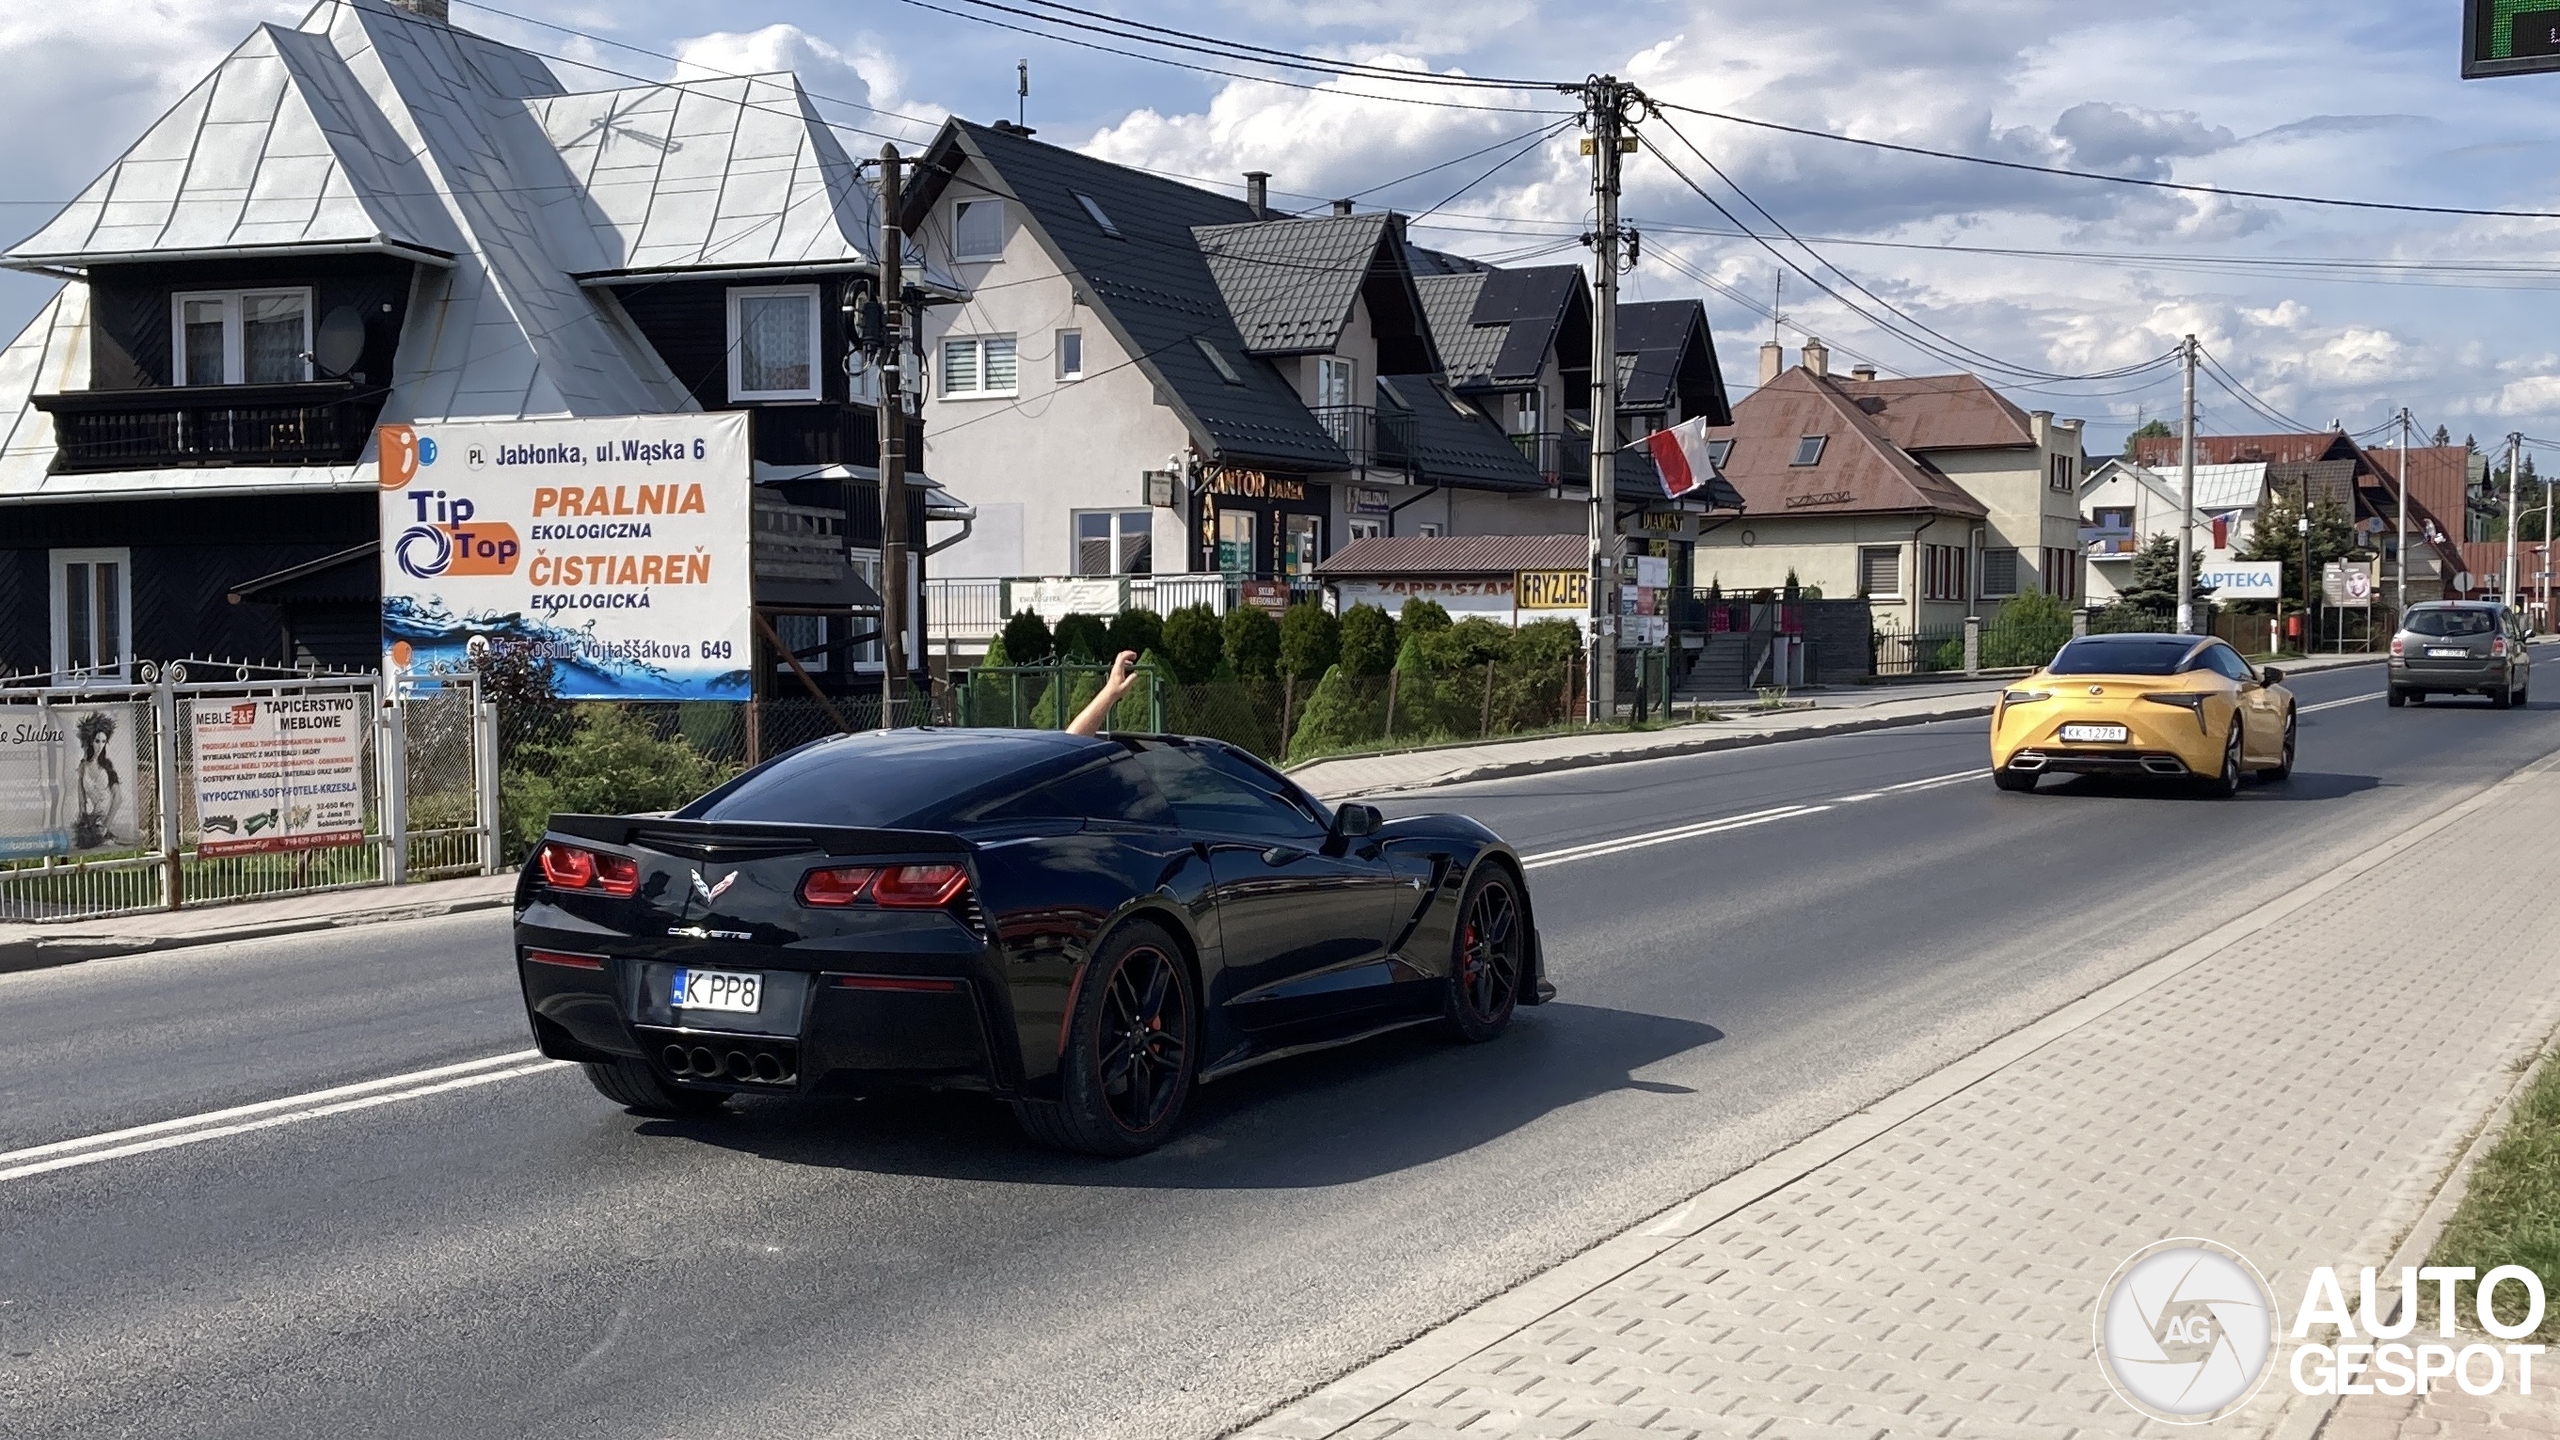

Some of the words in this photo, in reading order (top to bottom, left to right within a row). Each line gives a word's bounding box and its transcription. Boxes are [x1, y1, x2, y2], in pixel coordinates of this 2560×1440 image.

[469, 450, 485, 465] PL
[496, 443, 587, 467] Jabłonka,
[596, 439, 685, 467] ul.Wąska
[693, 438, 705, 460] 6
[1202, 466, 1265, 498] KANTOR
[408, 490, 475, 530] Tip
[532, 483, 706, 518] PRALNIA
[531, 523, 652, 540] EKOLOGICZNA
[454, 533, 518, 564] Top
[529, 545, 711, 587] ČISTIAREŇ
[2202, 572, 2273, 587] APTEKA
[530, 587, 651, 610] EKOLOGICKÁ
[582, 639, 691, 660] Vojtaššákova
[701, 641, 732, 660] 649
[264, 699, 354, 714] TAPICERSTWO
[196, 711, 232, 725] MEBLE
[280, 715, 342, 730] MEBLOWE
[2089, 728, 2121, 738] 12781
[667, 927, 753, 940] COVETTE
[686, 972, 703, 1003] K
[709, 975, 756, 1007] PP8
